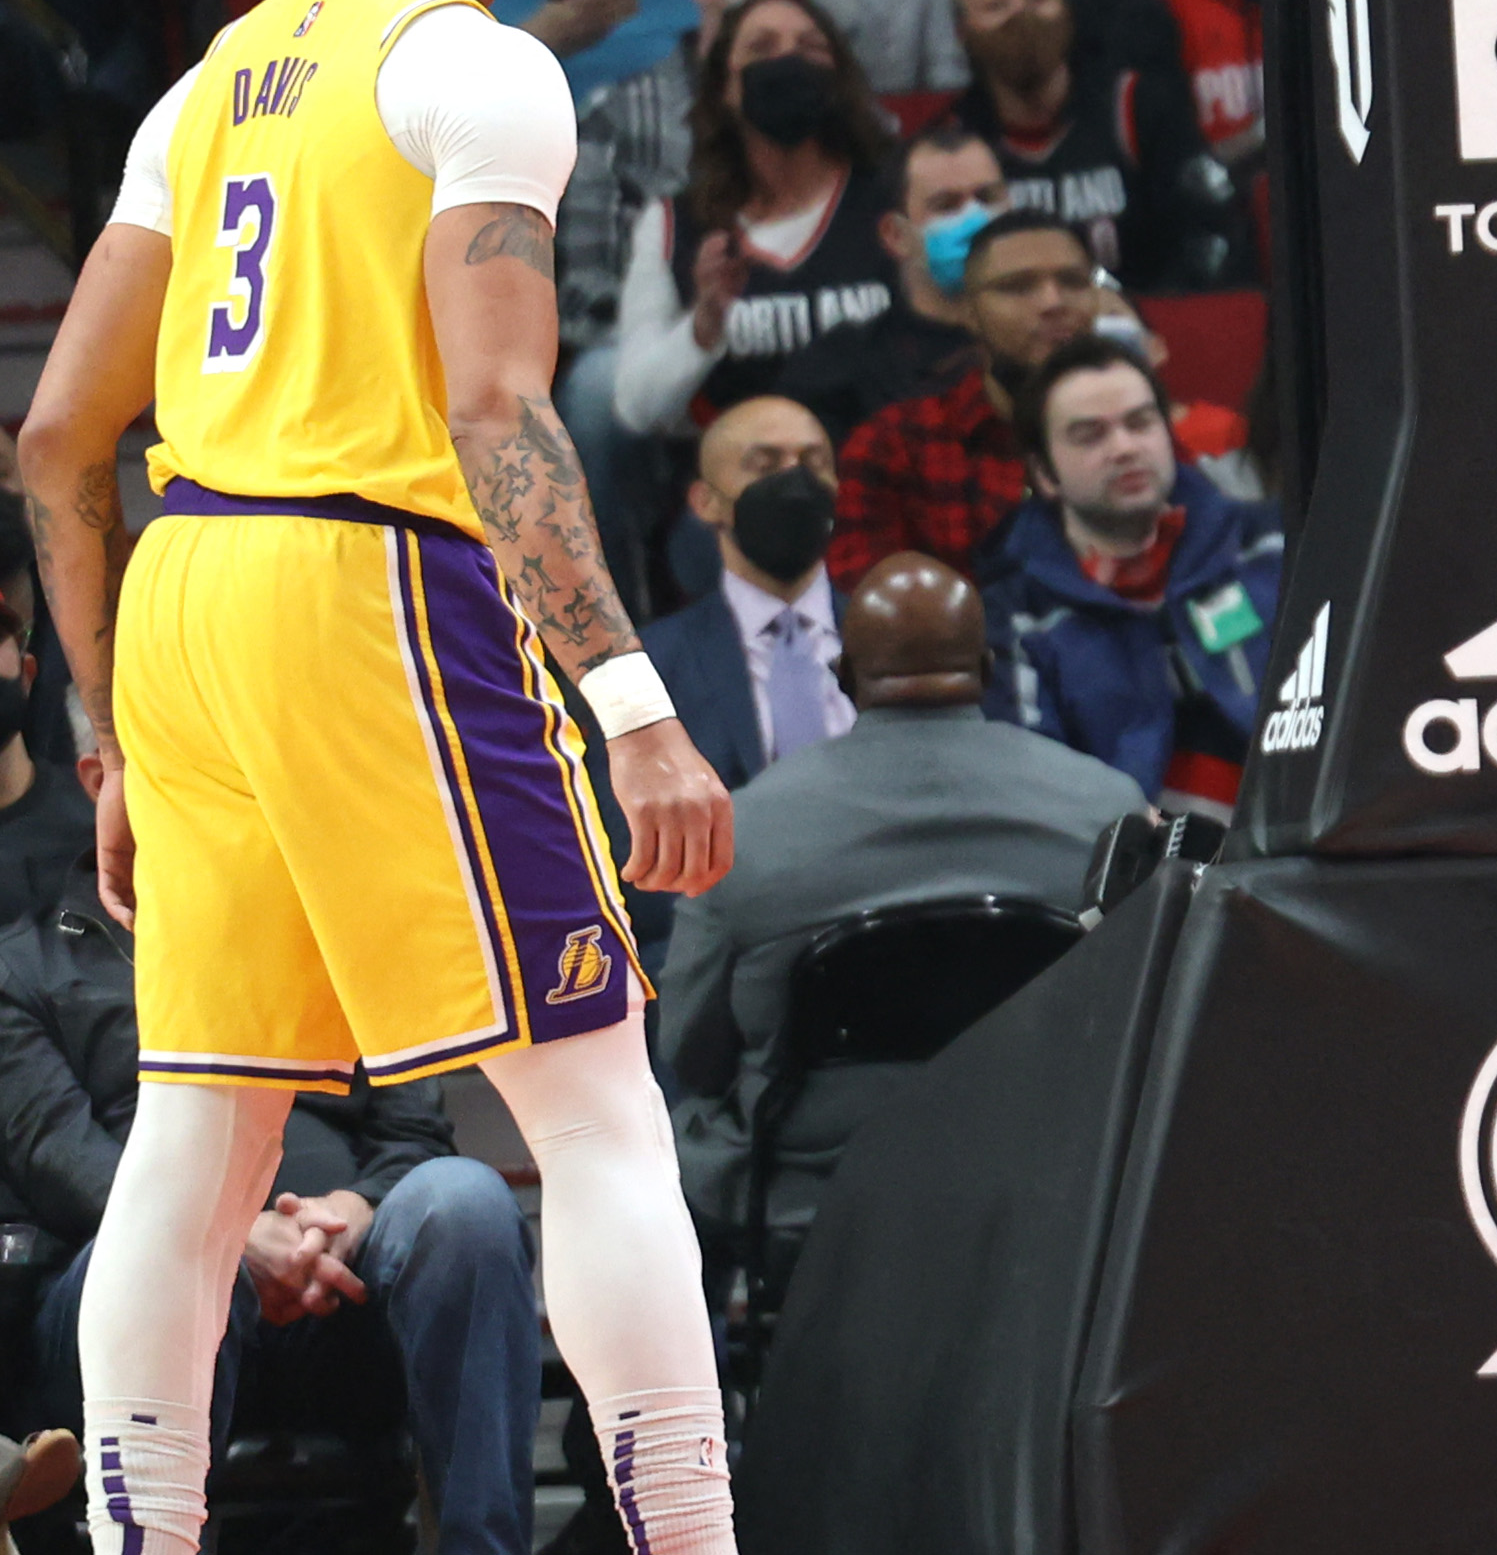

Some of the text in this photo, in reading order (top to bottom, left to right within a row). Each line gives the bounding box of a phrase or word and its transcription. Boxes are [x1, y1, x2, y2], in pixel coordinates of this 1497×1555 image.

[232, 56, 318, 127] DAVIS
[202, 170, 278, 375] 3
[724, 282, 892, 358] ORTLAND
[1261, 696, 1325, 756] adidas
